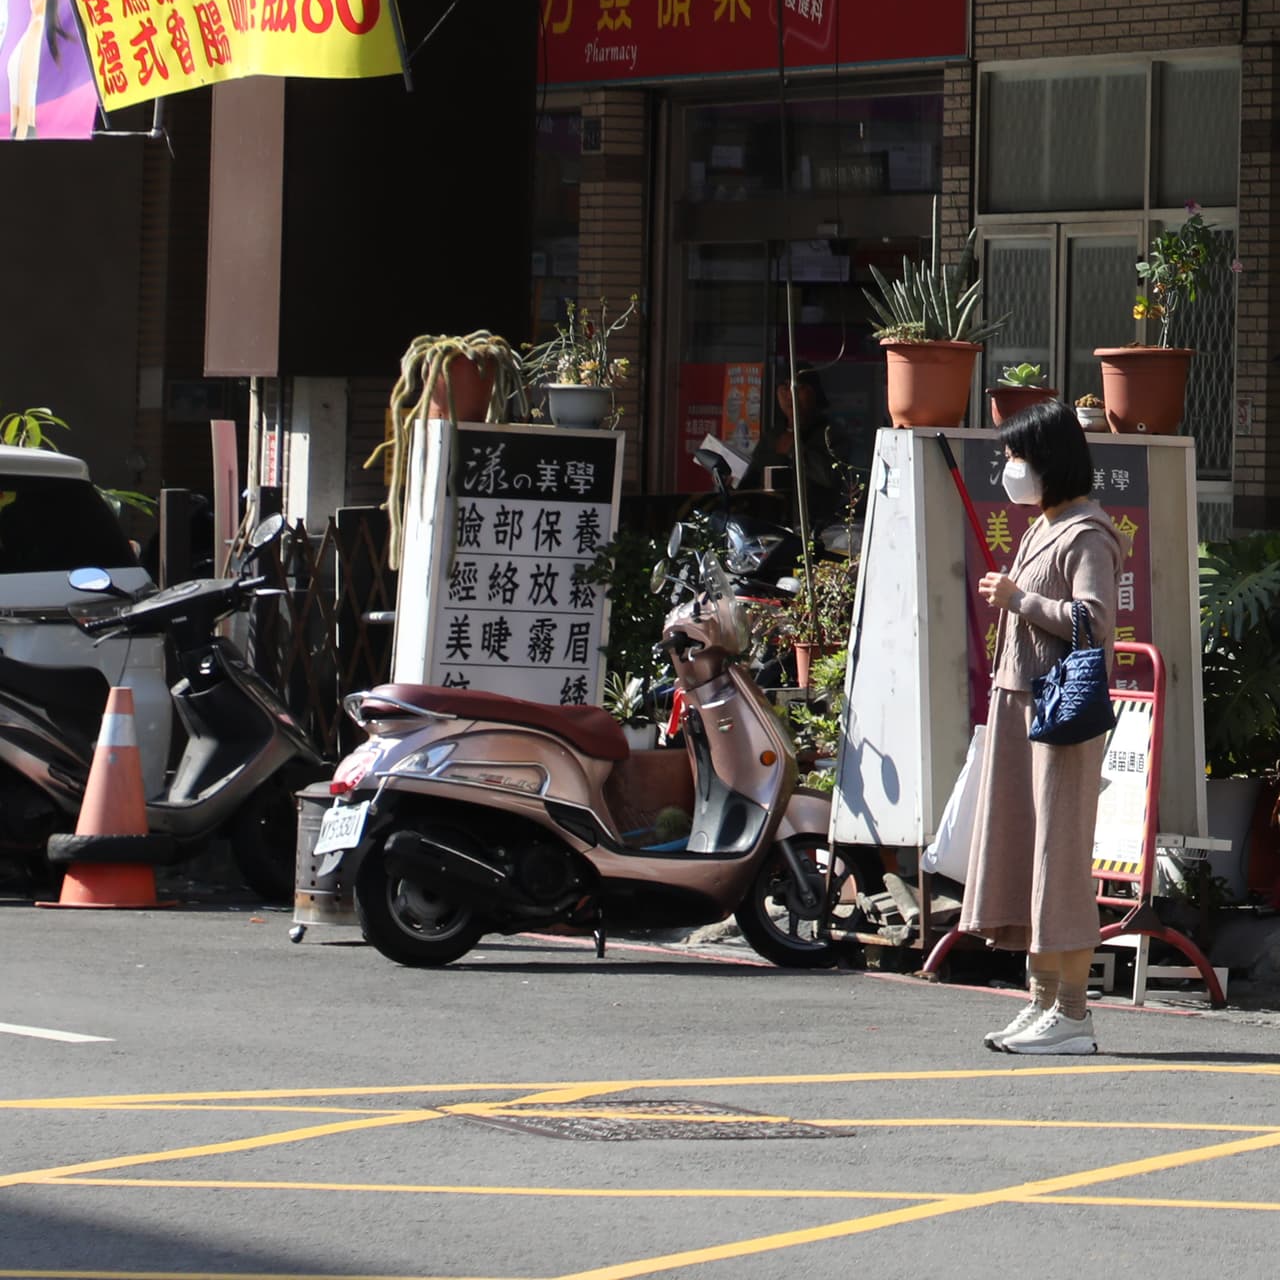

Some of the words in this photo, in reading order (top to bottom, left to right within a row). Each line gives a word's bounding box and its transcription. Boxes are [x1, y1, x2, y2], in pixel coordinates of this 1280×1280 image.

[97, 0, 233, 95] 德式香腸
[585, 41, 638, 71] Pharmacy
[456, 502, 603, 556] 臉部保養
[448, 560, 597, 611] 經絡放鬆
